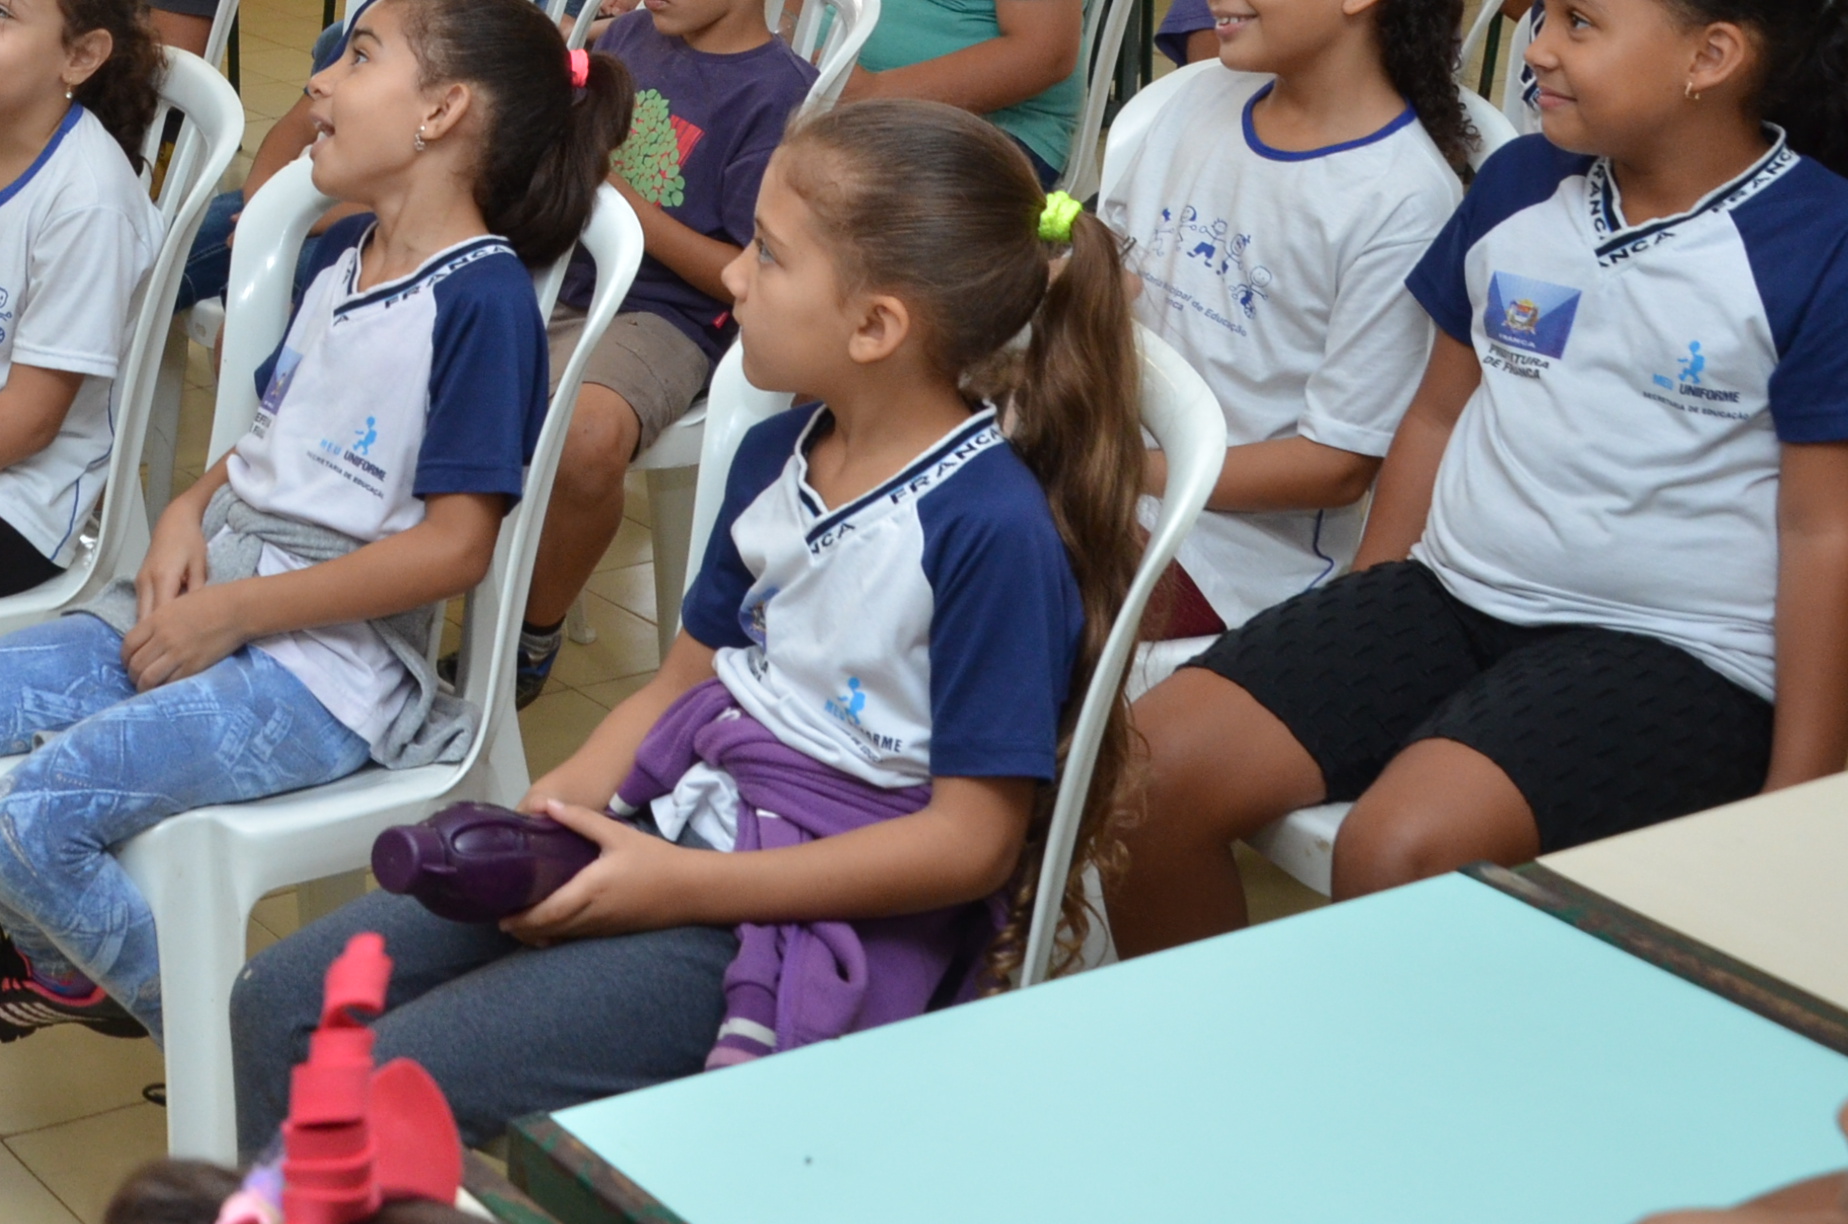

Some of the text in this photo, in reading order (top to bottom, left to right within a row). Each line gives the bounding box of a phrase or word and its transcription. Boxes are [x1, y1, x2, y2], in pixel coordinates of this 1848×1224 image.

[1191, 300, 1204, 312] de
[1203, 308, 1247, 337] Educação
[1483, 355, 1502, 368] DE
[1678, 383, 1740, 404] UNIFORME
[1687, 405, 1700, 414] DE
[343, 449, 387, 483] UNIFORME
